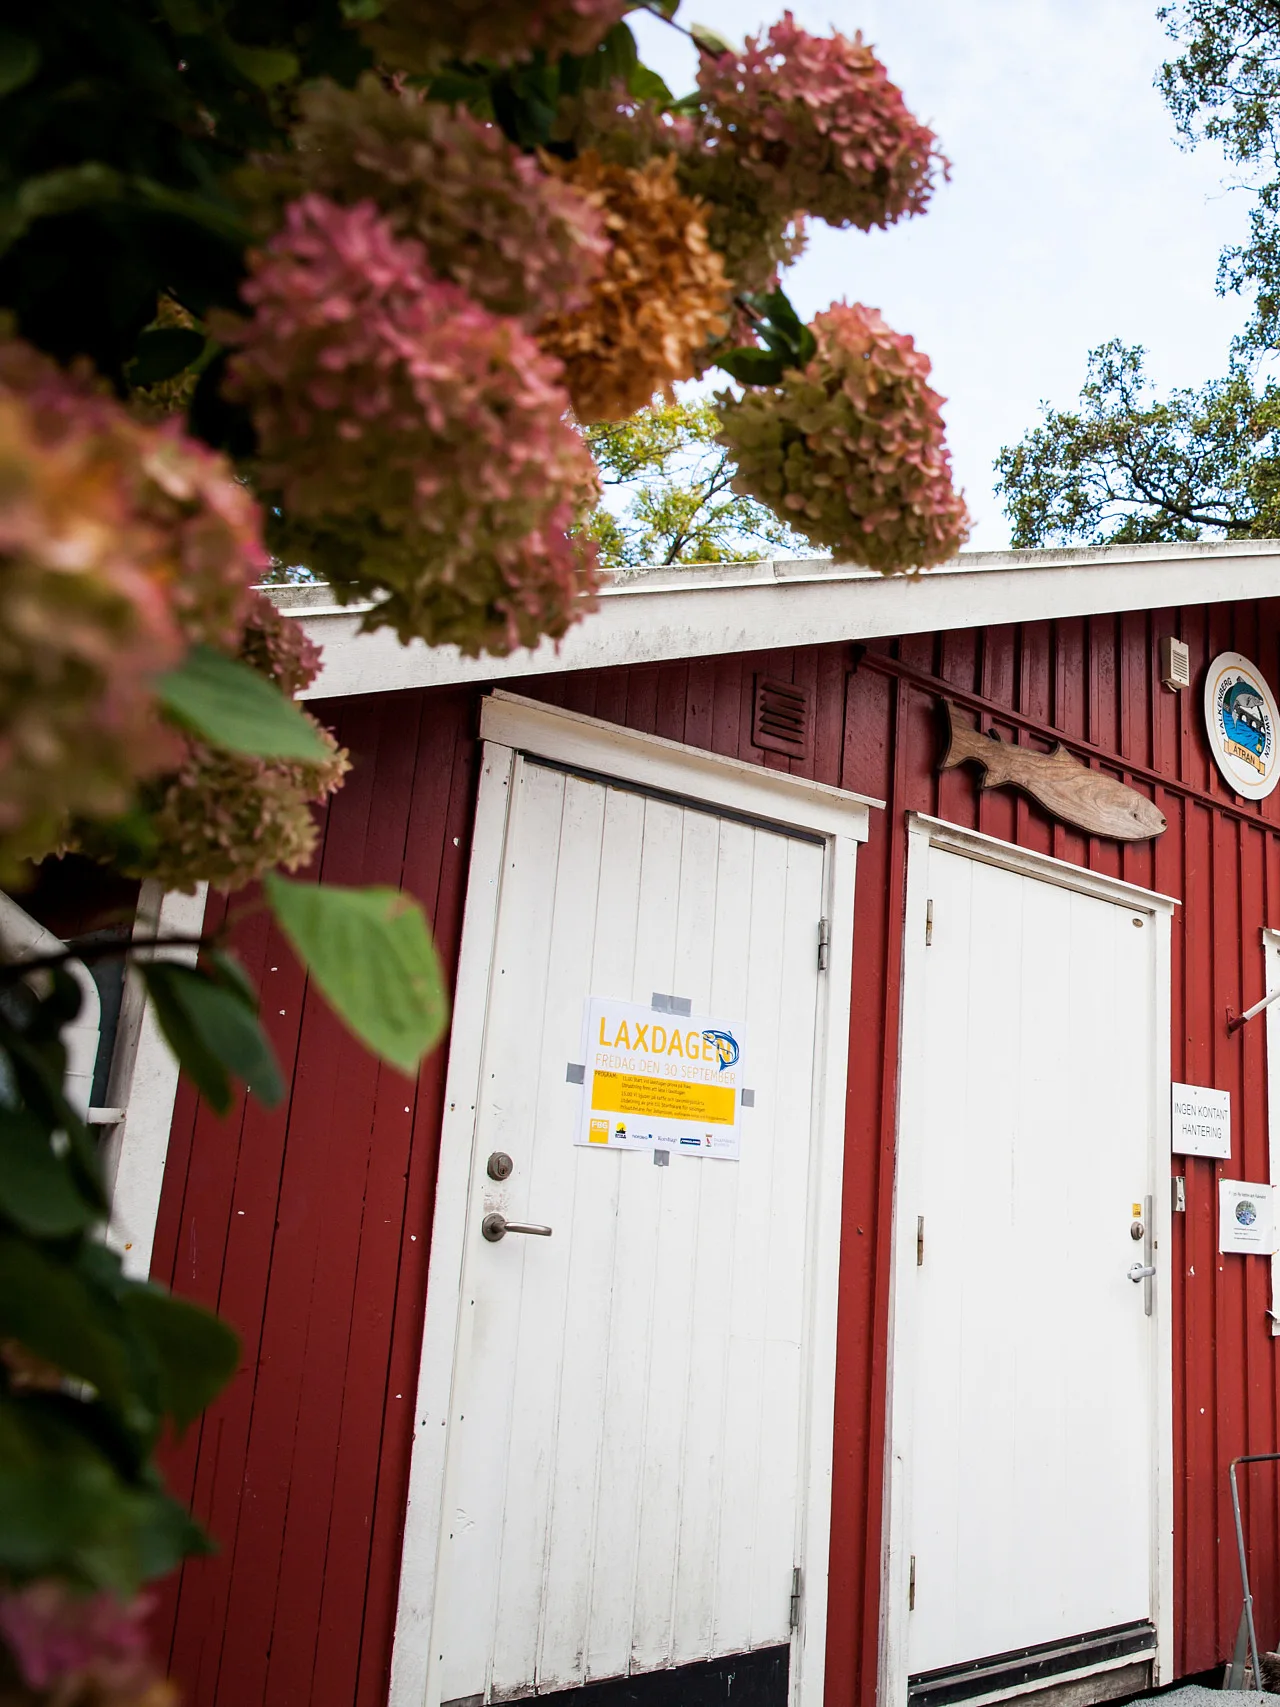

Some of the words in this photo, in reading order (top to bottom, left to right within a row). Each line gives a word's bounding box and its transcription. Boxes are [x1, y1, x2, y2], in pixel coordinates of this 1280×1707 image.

[1216, 676, 1233, 736] FALKENBERG
[1263, 714, 1272, 759] SWEDEN
[599, 1016, 731, 1062] LAXDAGEN
[595, 1053, 636, 1071] FREDAG
[639, 1059, 660, 1074] DEN
[664, 1063, 678, 1077] 30
[681, 1065, 736, 1085] SEPTEMBER
[1174, 1102, 1197, 1116] INGEN
[1197, 1105, 1229, 1121] KONTANT
[1182, 1123, 1222, 1139] HANTERING
